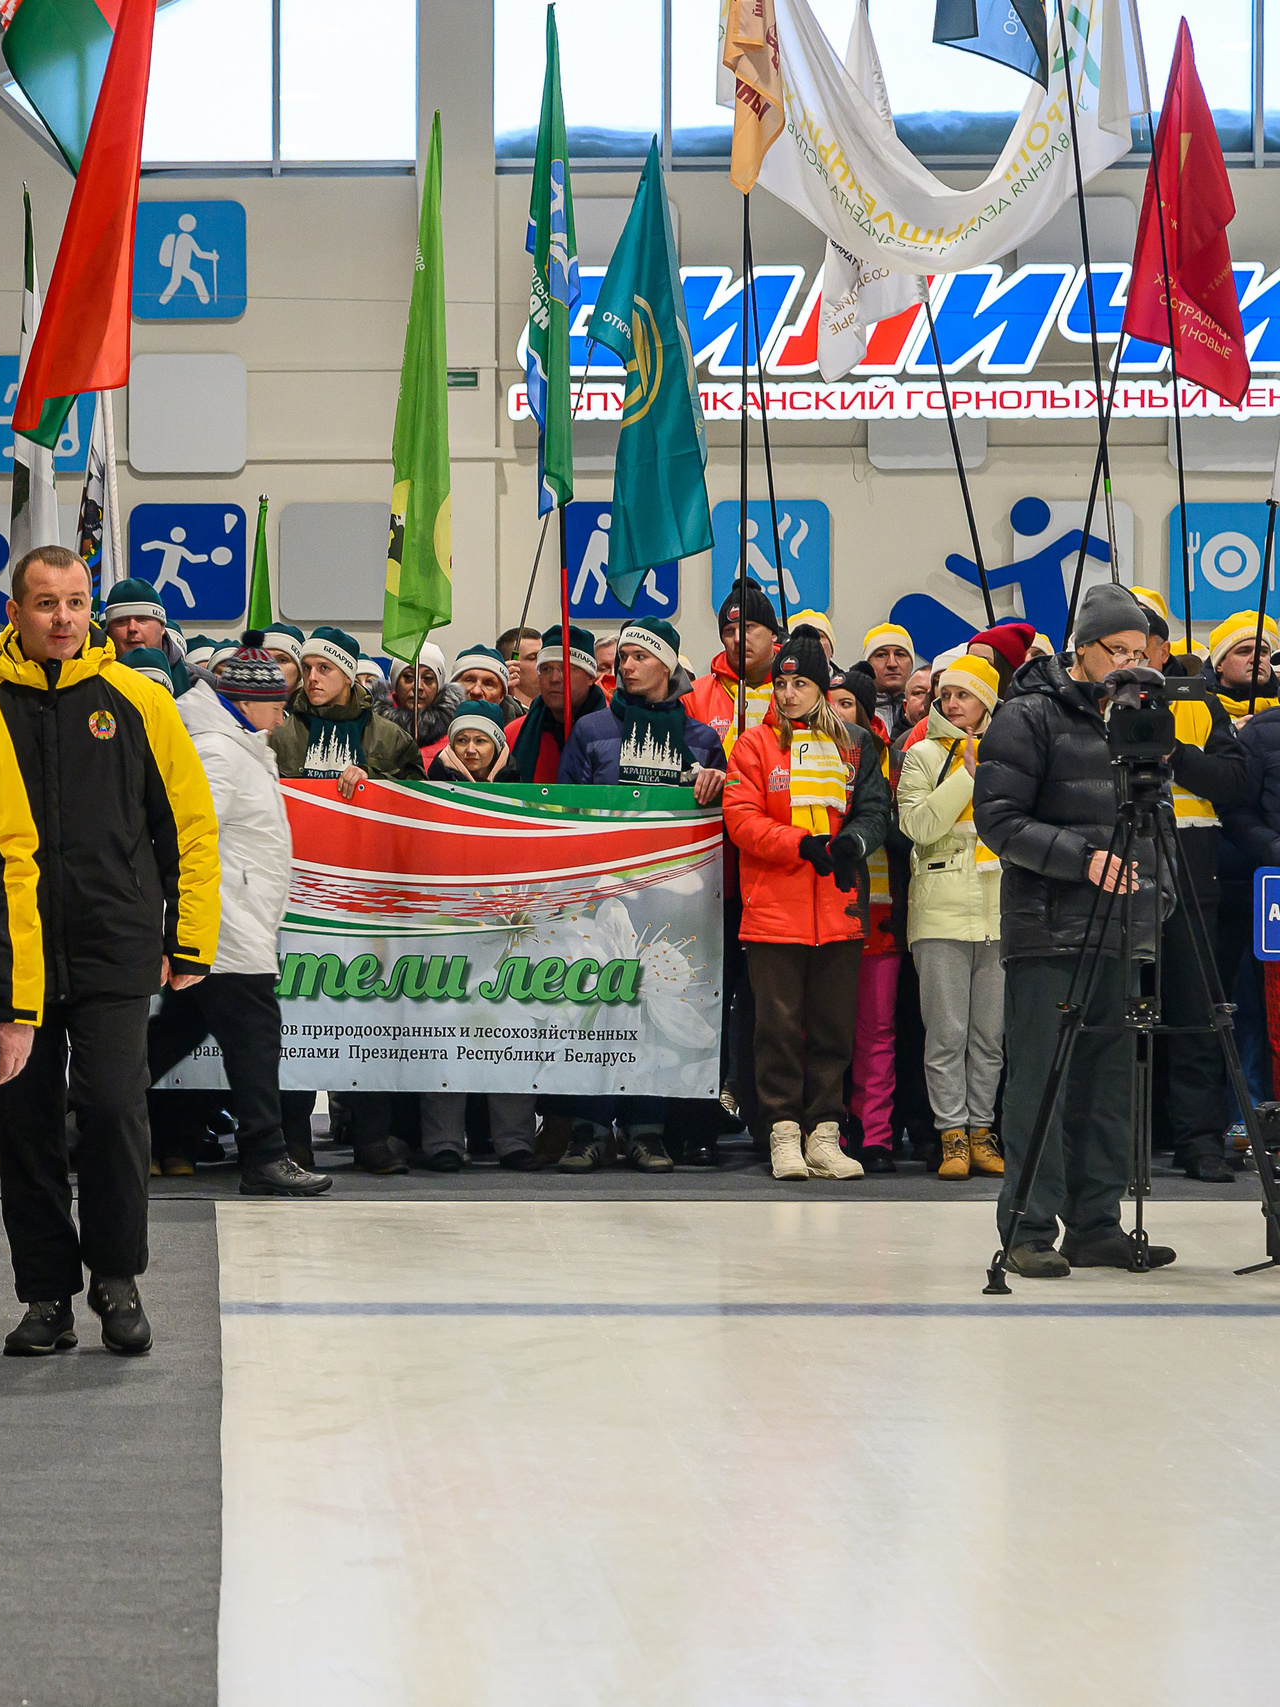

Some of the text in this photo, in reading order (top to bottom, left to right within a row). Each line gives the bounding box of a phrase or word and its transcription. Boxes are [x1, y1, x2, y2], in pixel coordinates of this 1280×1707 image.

[905, 384, 1208, 411] ГОРНОЛЫЖНЫЙ
[622, 766, 678, 779] ХРАНИТЕЛИ
[478, 955, 641, 1003] леса
[302, 1023, 457, 1041] природоохранных
[460, 1027, 470, 1038] и
[473, 1025, 638, 1042] лесохозяйственных
[279, 1046, 339, 1061] делами
[348, 1045, 448, 1062] Президента
[456, 1046, 555, 1065] Республики
[564, 1048, 636, 1067] Беларусь
